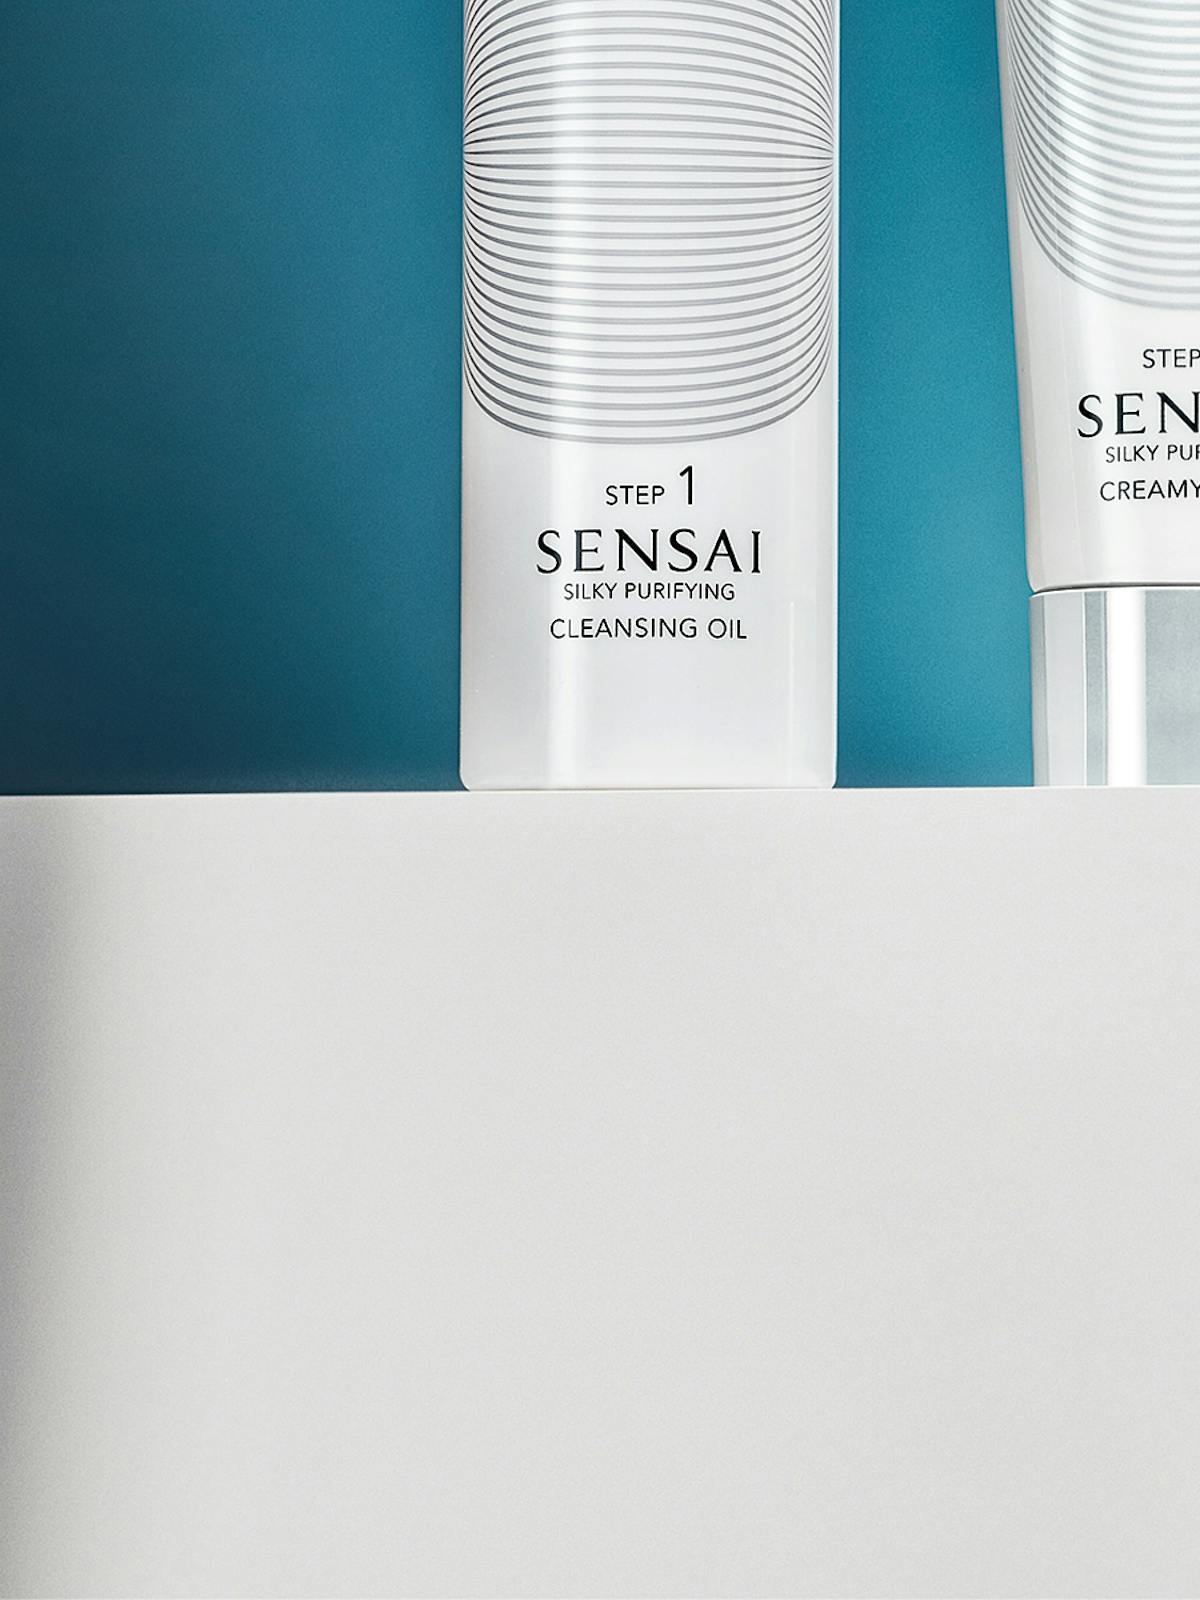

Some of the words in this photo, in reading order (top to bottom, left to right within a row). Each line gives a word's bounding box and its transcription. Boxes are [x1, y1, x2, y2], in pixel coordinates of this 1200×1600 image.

[1105, 444, 1160, 464] SILKY
[605, 484, 667, 507] STEP
[678, 464, 693, 506] 1
[536, 527, 761, 575] SENSAI
[563, 581, 618, 601] SILKY
[624, 581, 736, 601] PURIFYING
[549, 617, 698, 640] CLEANSING
[707, 617, 748, 640] OIL
